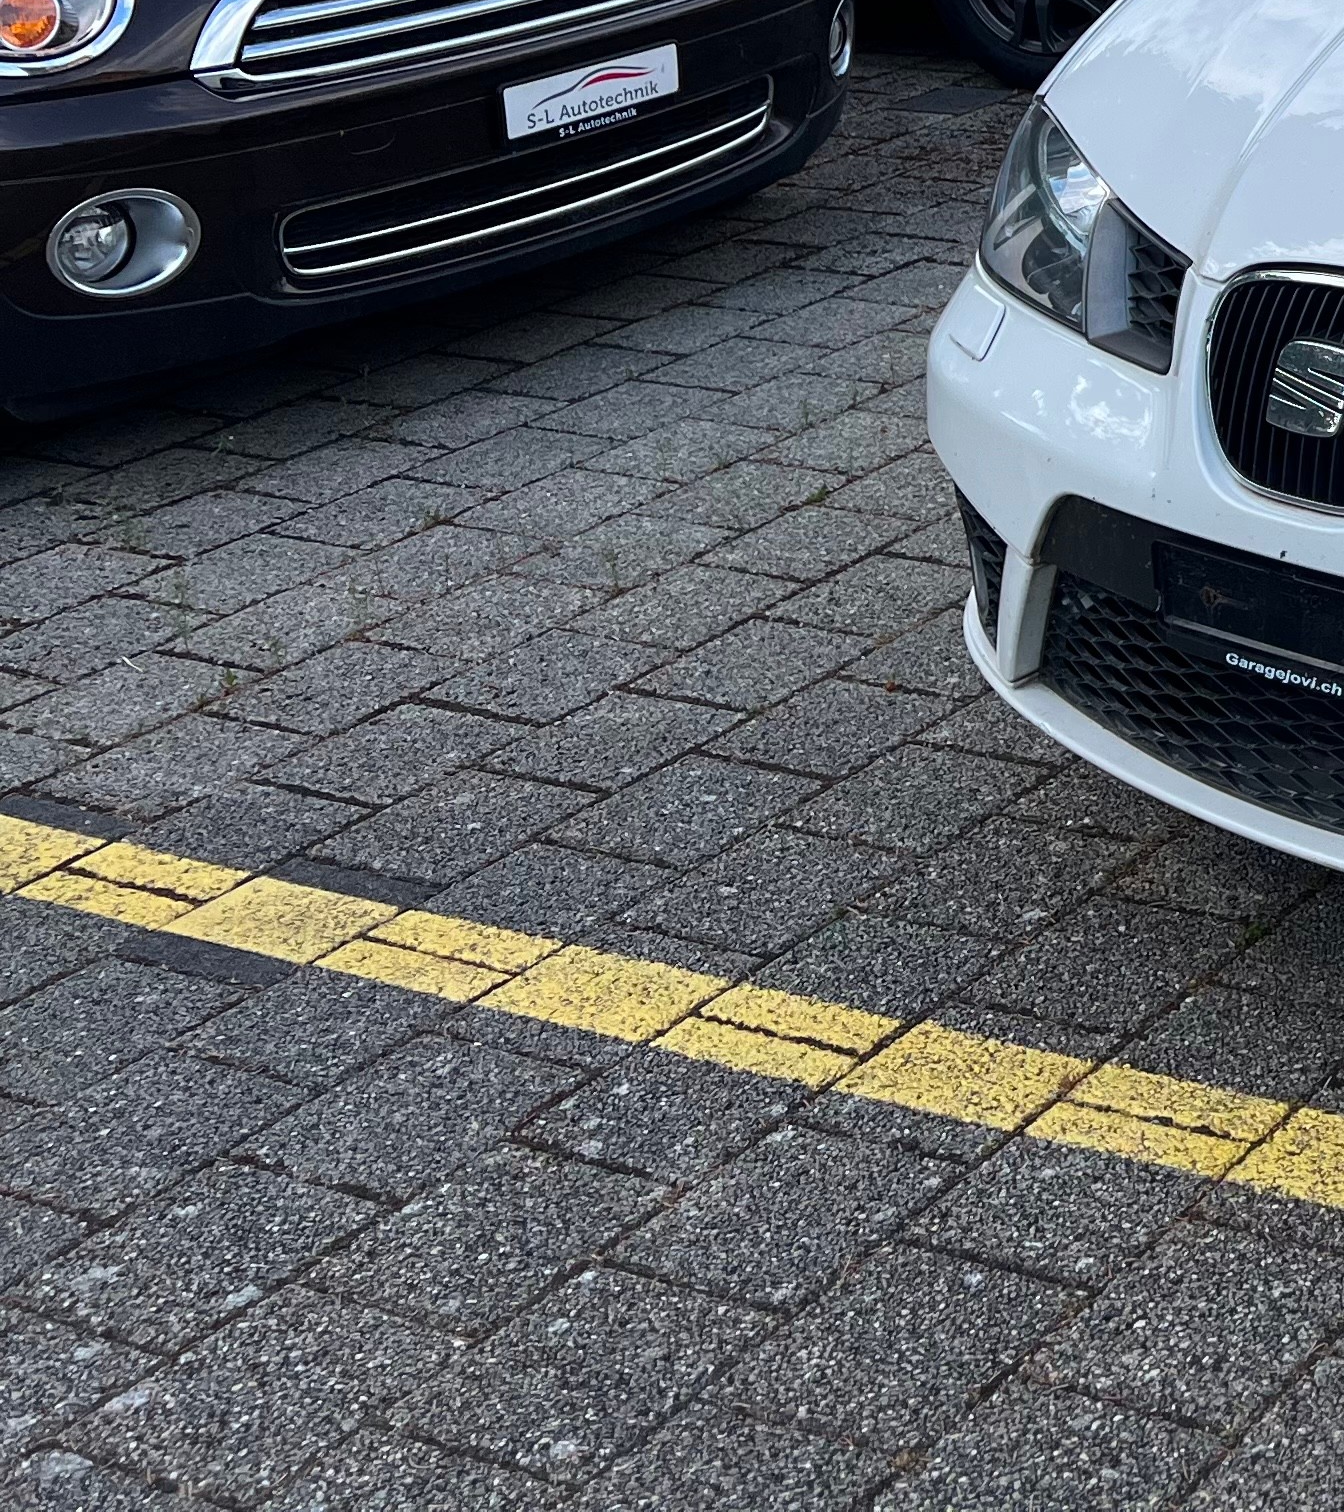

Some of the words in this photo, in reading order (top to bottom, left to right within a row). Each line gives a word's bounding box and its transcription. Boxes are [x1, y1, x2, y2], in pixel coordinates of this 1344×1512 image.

[527, 108, 555, 129] S-L
[559, 80, 659, 121] Autotechnik
[558, 124, 576, 138] S-L
[577, 107, 637, 133] Autotechnik
[1225, 652, 1343, 697] Garagejovi.ch
